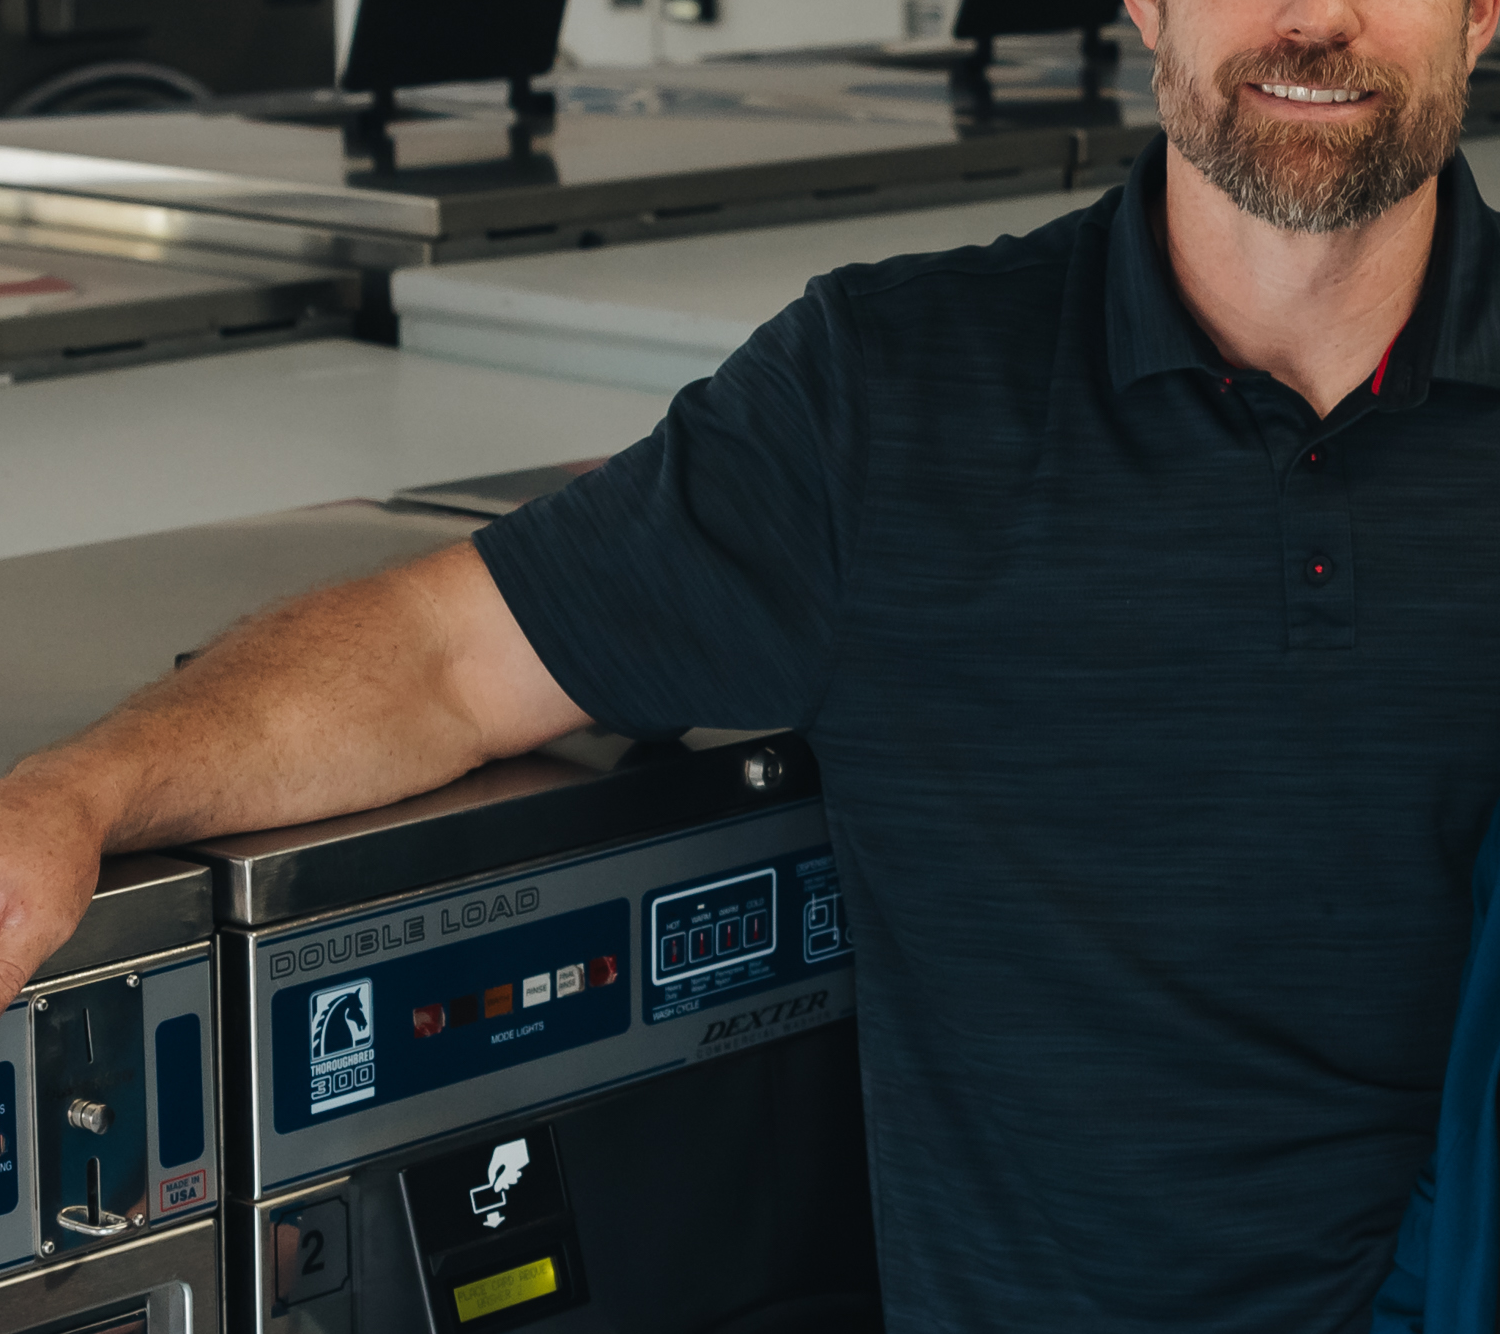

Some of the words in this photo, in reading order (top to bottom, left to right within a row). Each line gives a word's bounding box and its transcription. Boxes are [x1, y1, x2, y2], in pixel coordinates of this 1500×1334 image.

[270, 916, 425, 980] DOUBLE
[441, 887, 539, 935] LOAD
[526, 983, 547, 996] RINSE
[491, 1030, 515, 1044] MODE
[517, 1021, 544, 1038] LIGHTS
[699, 990, 828, 1046] DEXTER
[310, 1048, 374, 1077] THOROUGHBRED
[310, 1062, 375, 1100] 300
[166, 1179, 188, 1192] MADE
[191, 1175, 199, 1184] IN
[170, 1187, 196, 1205] USA
[302, 1229, 325, 1276] 2
